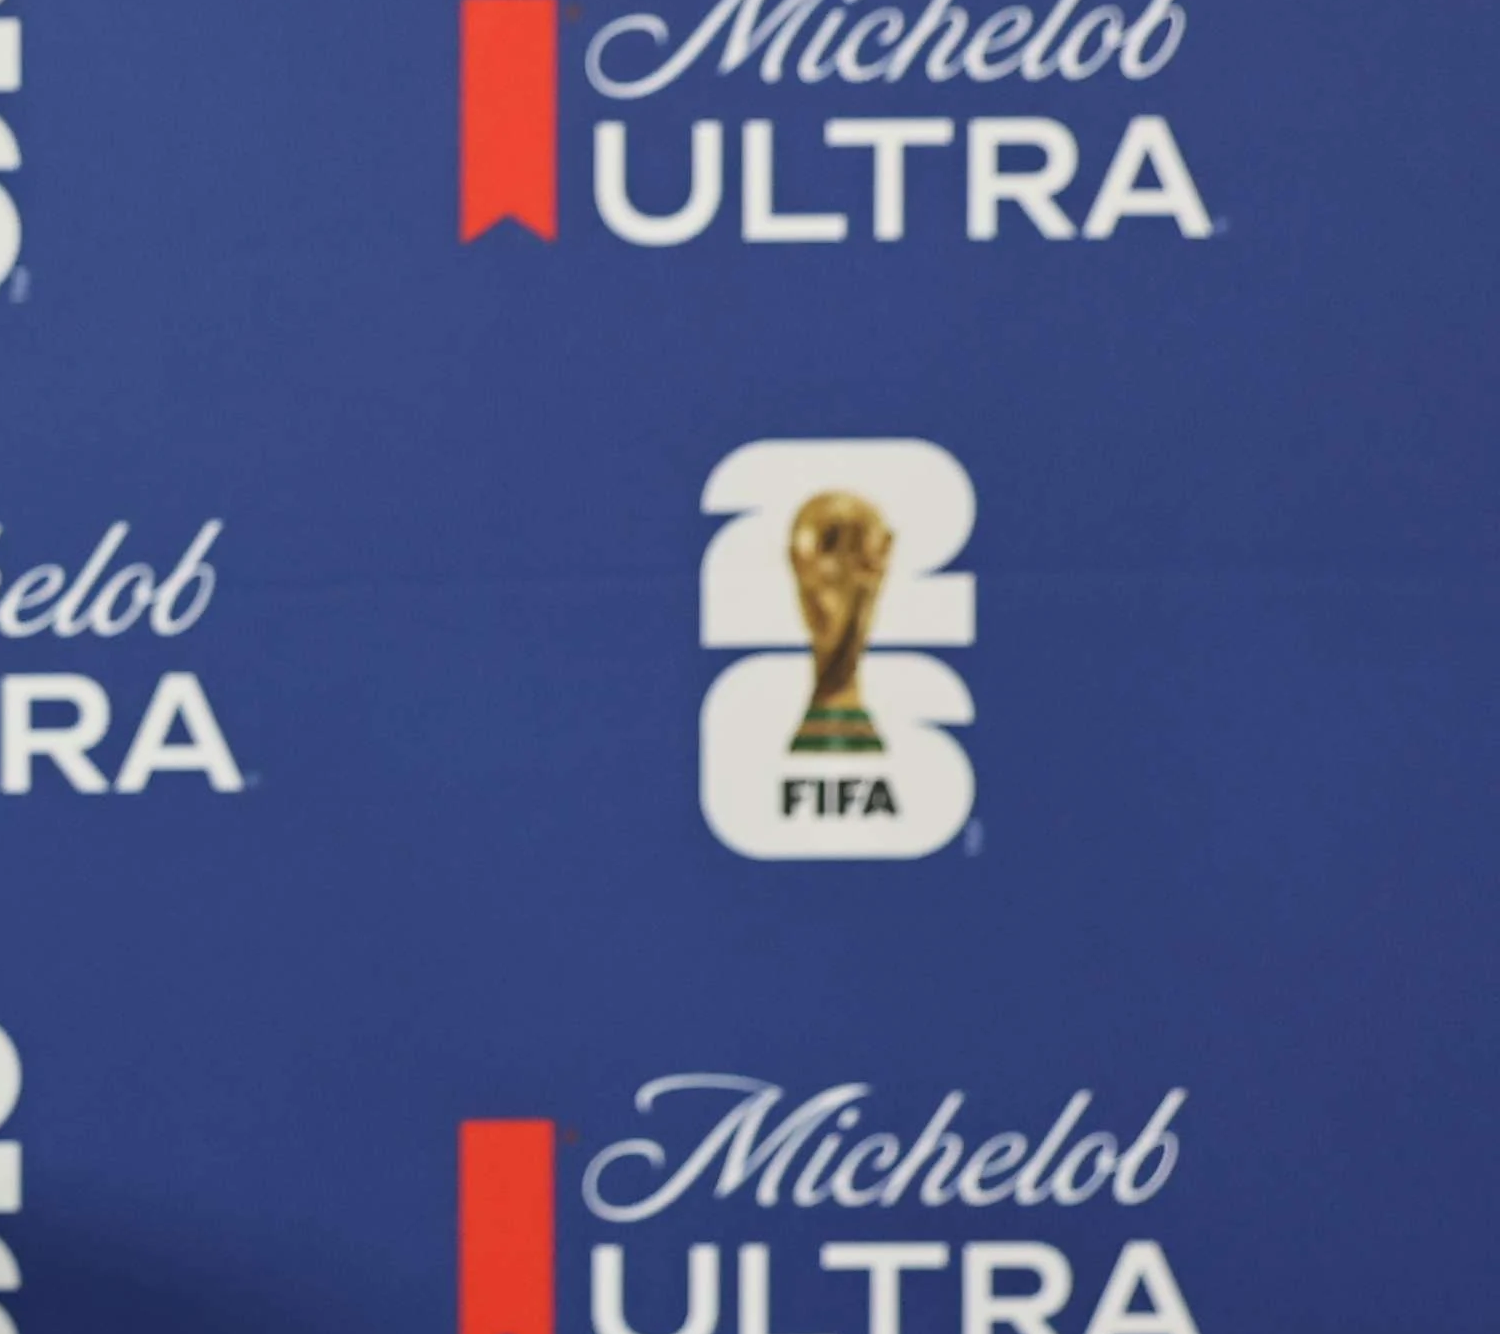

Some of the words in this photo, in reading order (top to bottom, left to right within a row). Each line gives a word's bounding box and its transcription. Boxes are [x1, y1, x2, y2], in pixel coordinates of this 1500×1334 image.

[594, 115, 1214, 246] ULTRA
[782, 779, 897, 816] FIFA
[583, 1074, 1185, 1222] Michelob
